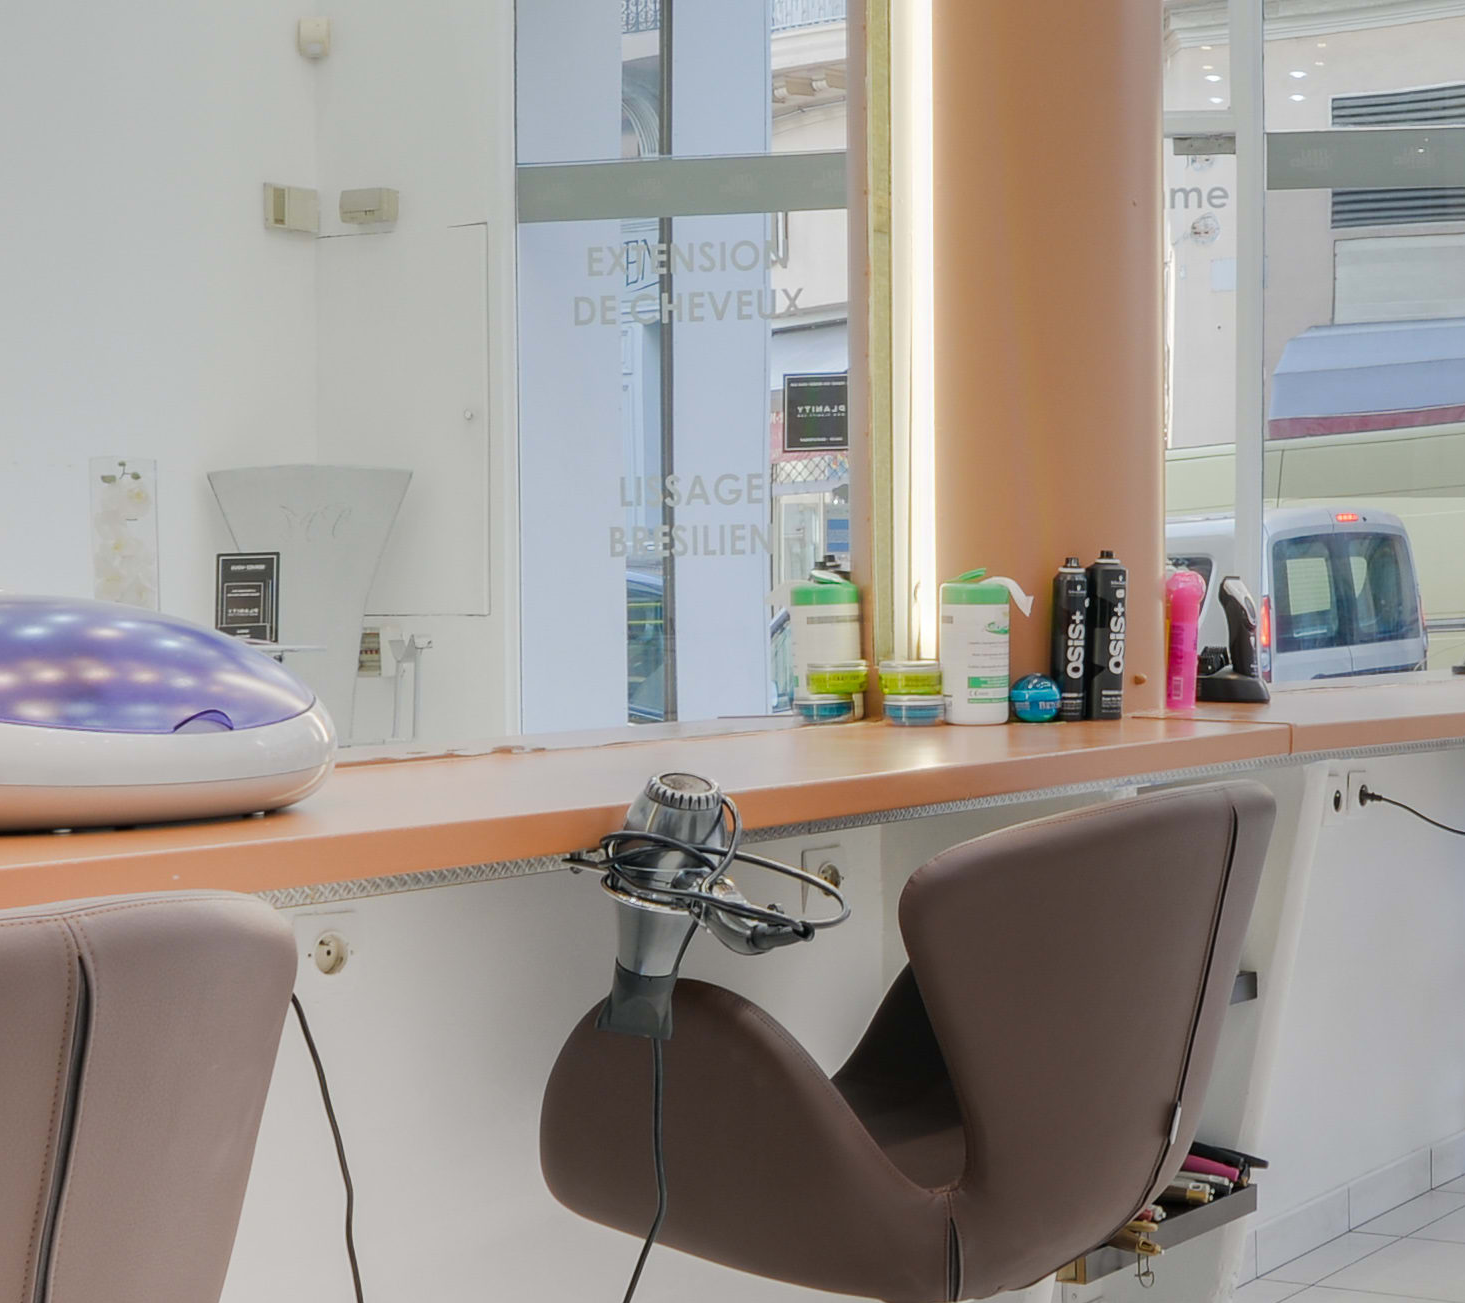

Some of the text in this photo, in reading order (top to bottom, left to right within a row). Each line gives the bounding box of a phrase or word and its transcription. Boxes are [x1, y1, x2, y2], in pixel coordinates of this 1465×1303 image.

[587, 240, 790, 277] EXTENSION
[574, 288, 804, 326] DE CHEVEUX
[620, 473, 764, 507] LISSAGE
[610, 524, 773, 557] BRESILIEN
